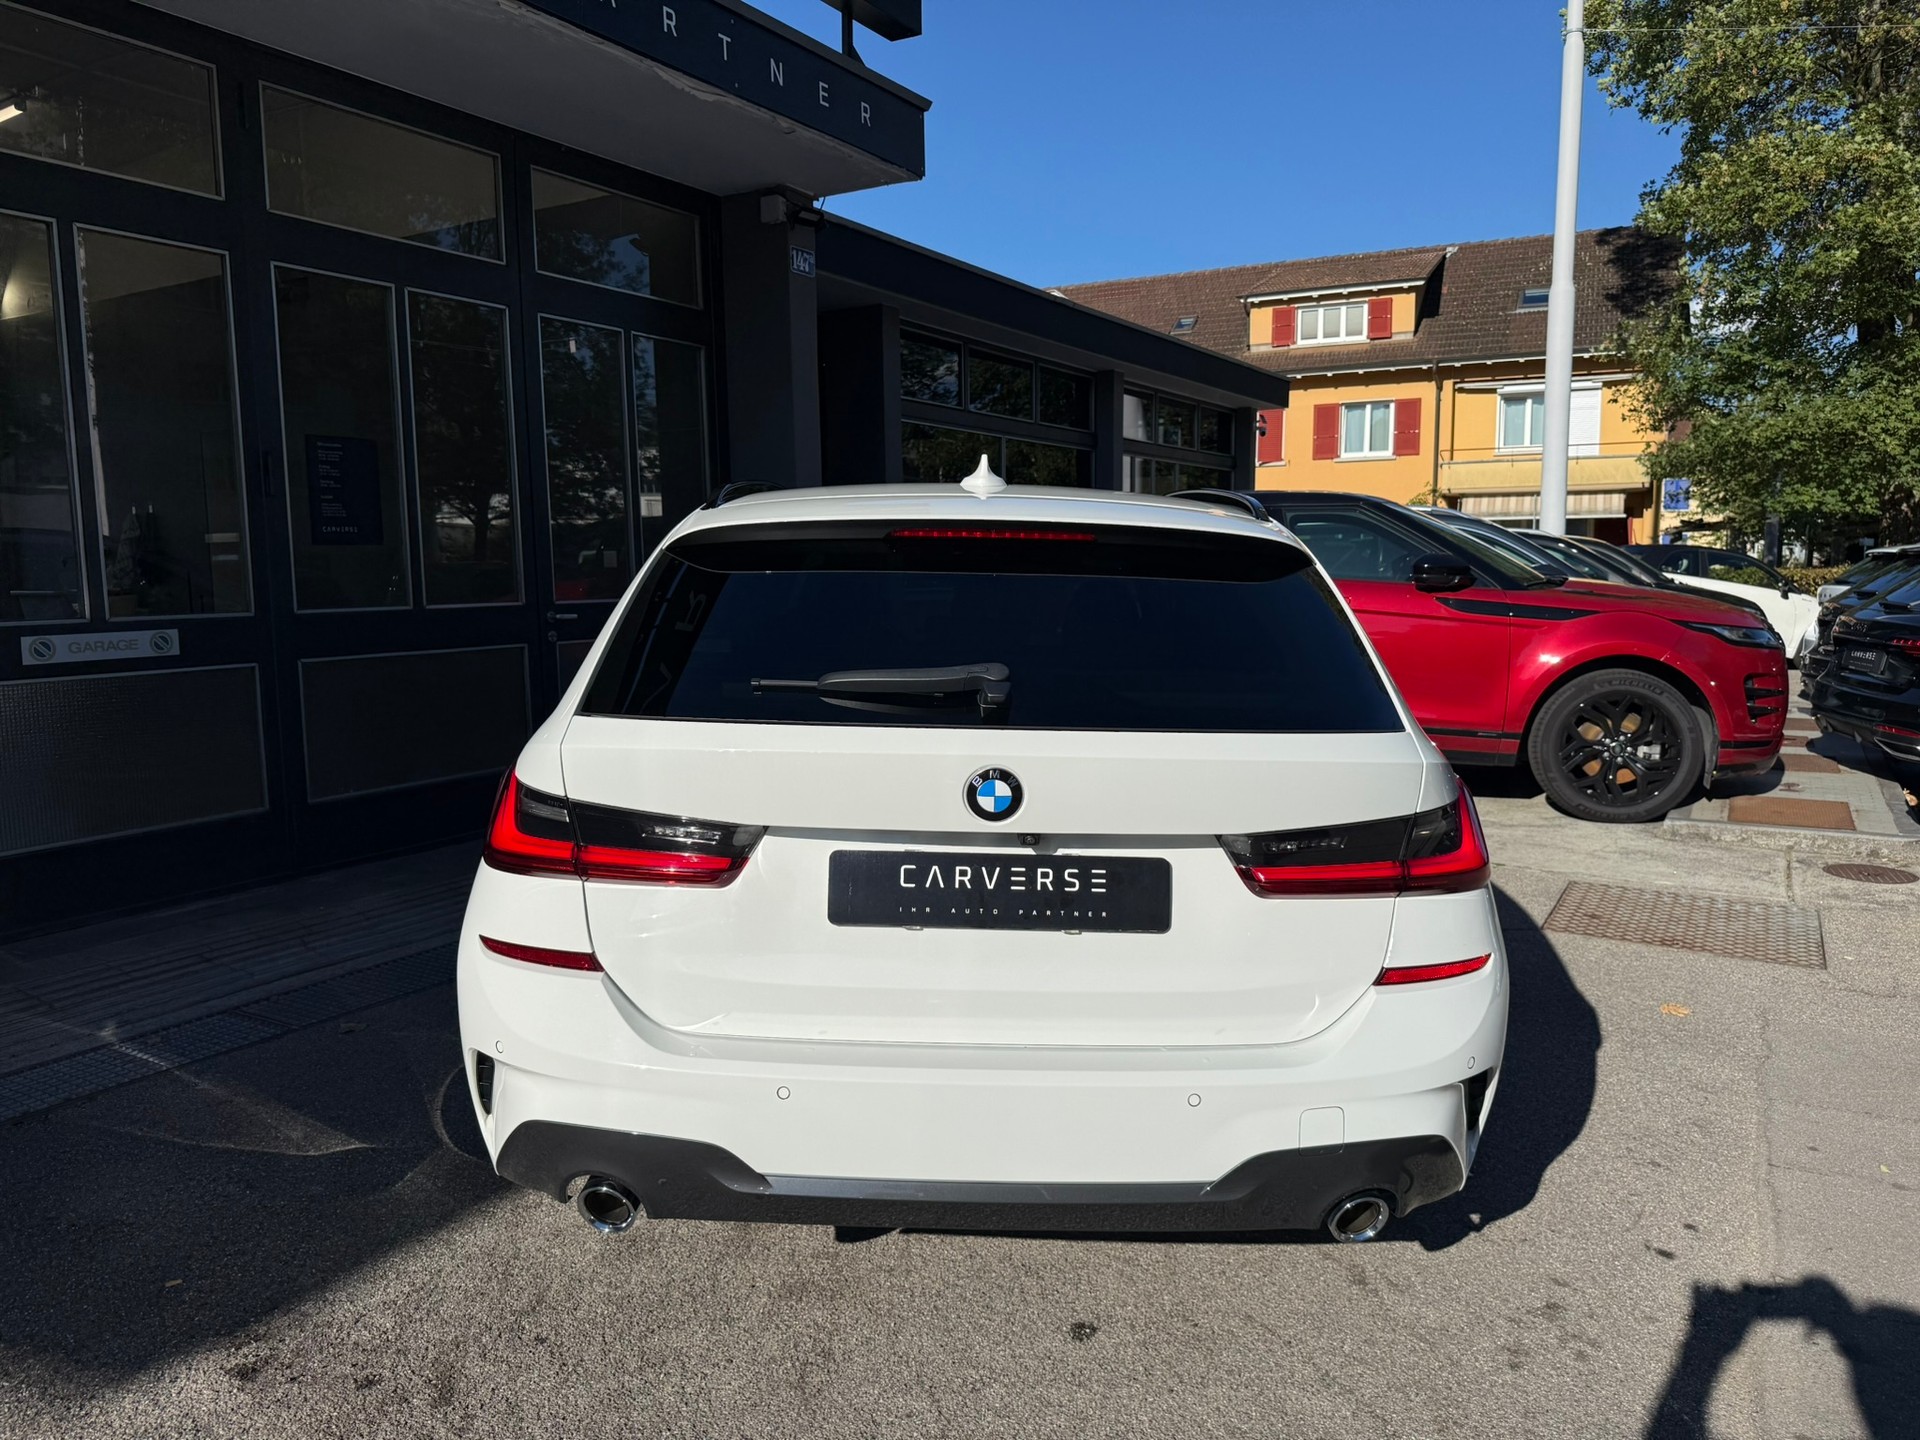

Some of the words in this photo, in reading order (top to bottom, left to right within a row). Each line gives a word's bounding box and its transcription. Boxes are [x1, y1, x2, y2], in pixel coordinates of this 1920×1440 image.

[600, 0, 871, 127] RTNER
[68, 639, 139, 654] GARAGE
[972, 770, 1018, 788] BMW
[900, 865, 1106, 892] CARVERSE
[951, 907, 998, 915] AUTO
[1018, 909, 1107, 918] PARTNER
